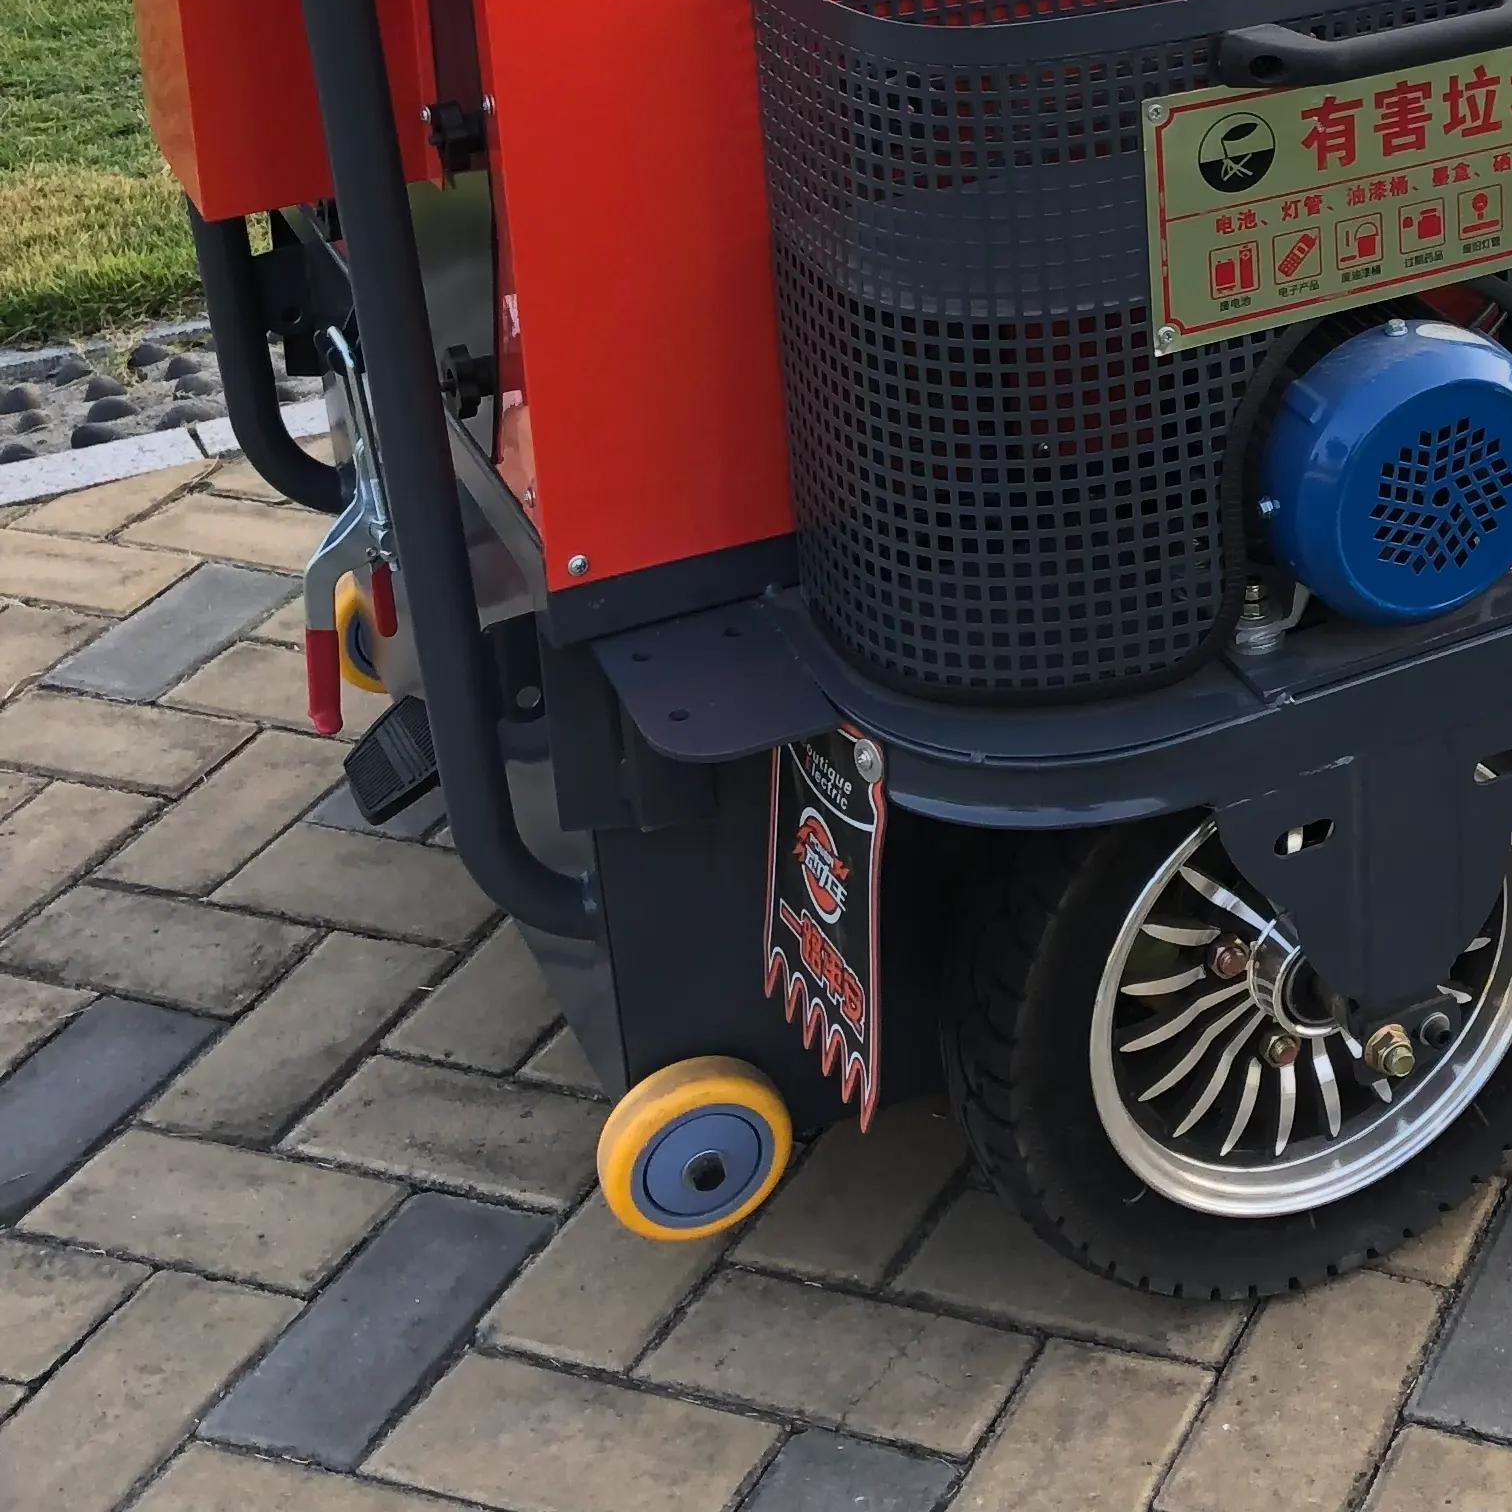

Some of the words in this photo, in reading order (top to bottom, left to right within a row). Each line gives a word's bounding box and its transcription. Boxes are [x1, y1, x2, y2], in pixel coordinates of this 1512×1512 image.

[1277, 279, 1321, 299] 电子产品
[801, 741, 852, 795] outique
